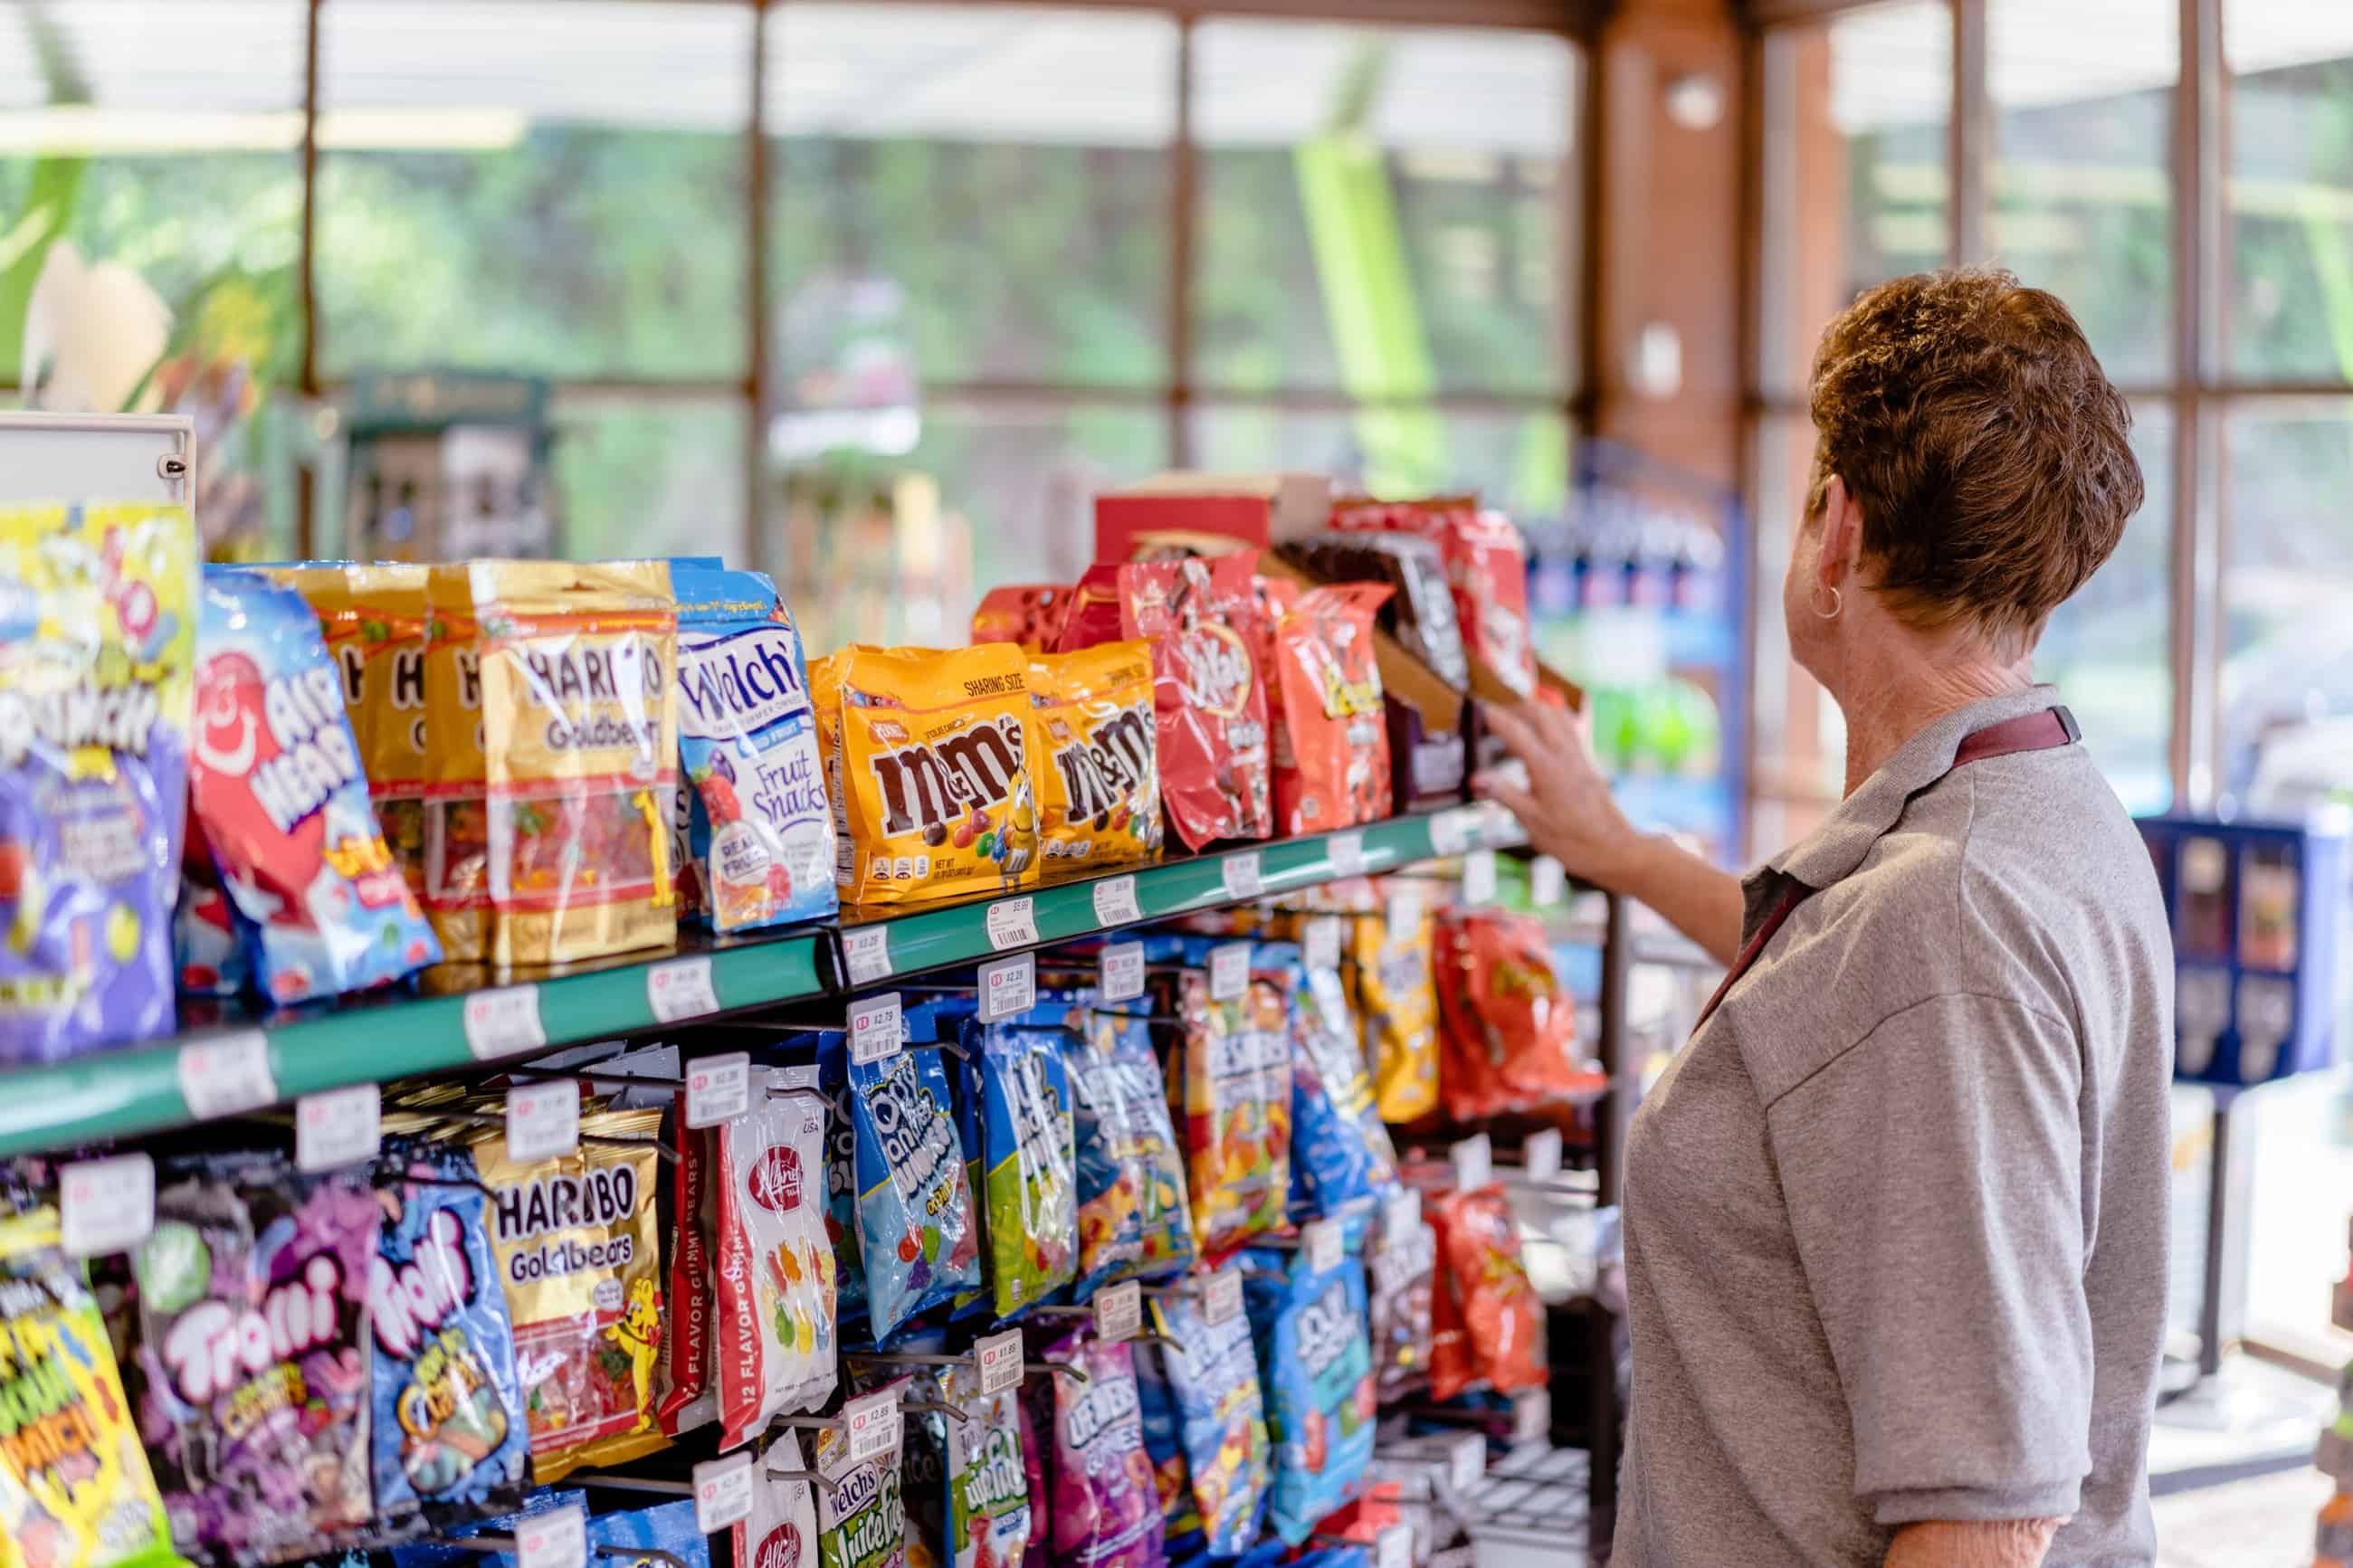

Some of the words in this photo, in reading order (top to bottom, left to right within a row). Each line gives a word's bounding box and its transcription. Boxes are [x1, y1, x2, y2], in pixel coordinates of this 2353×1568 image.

[529, 648, 662, 702] HARIO
[678, 640, 800, 722] Welch'
[964, 676, 1005, 697] SHARING
[1005, 673, 1025, 691] SIZE
[265, 667, 342, 749] AIR
[250, 723, 359, 835] HEAD
[754, 748, 812, 795] Fruit
[753, 779, 826, 825] Snacks
[803, 1122, 819, 1134] USA
[499, 1167, 634, 1239] HARIBO
[510, 1236, 631, 1282] Goldbears
[689, 1295, 703, 1374] FLAVOR
[738, 1298, 755, 1379] FLAVOR
[741, 1384, 756, 1405] 12
[826, 1469, 876, 1519] Welch's
